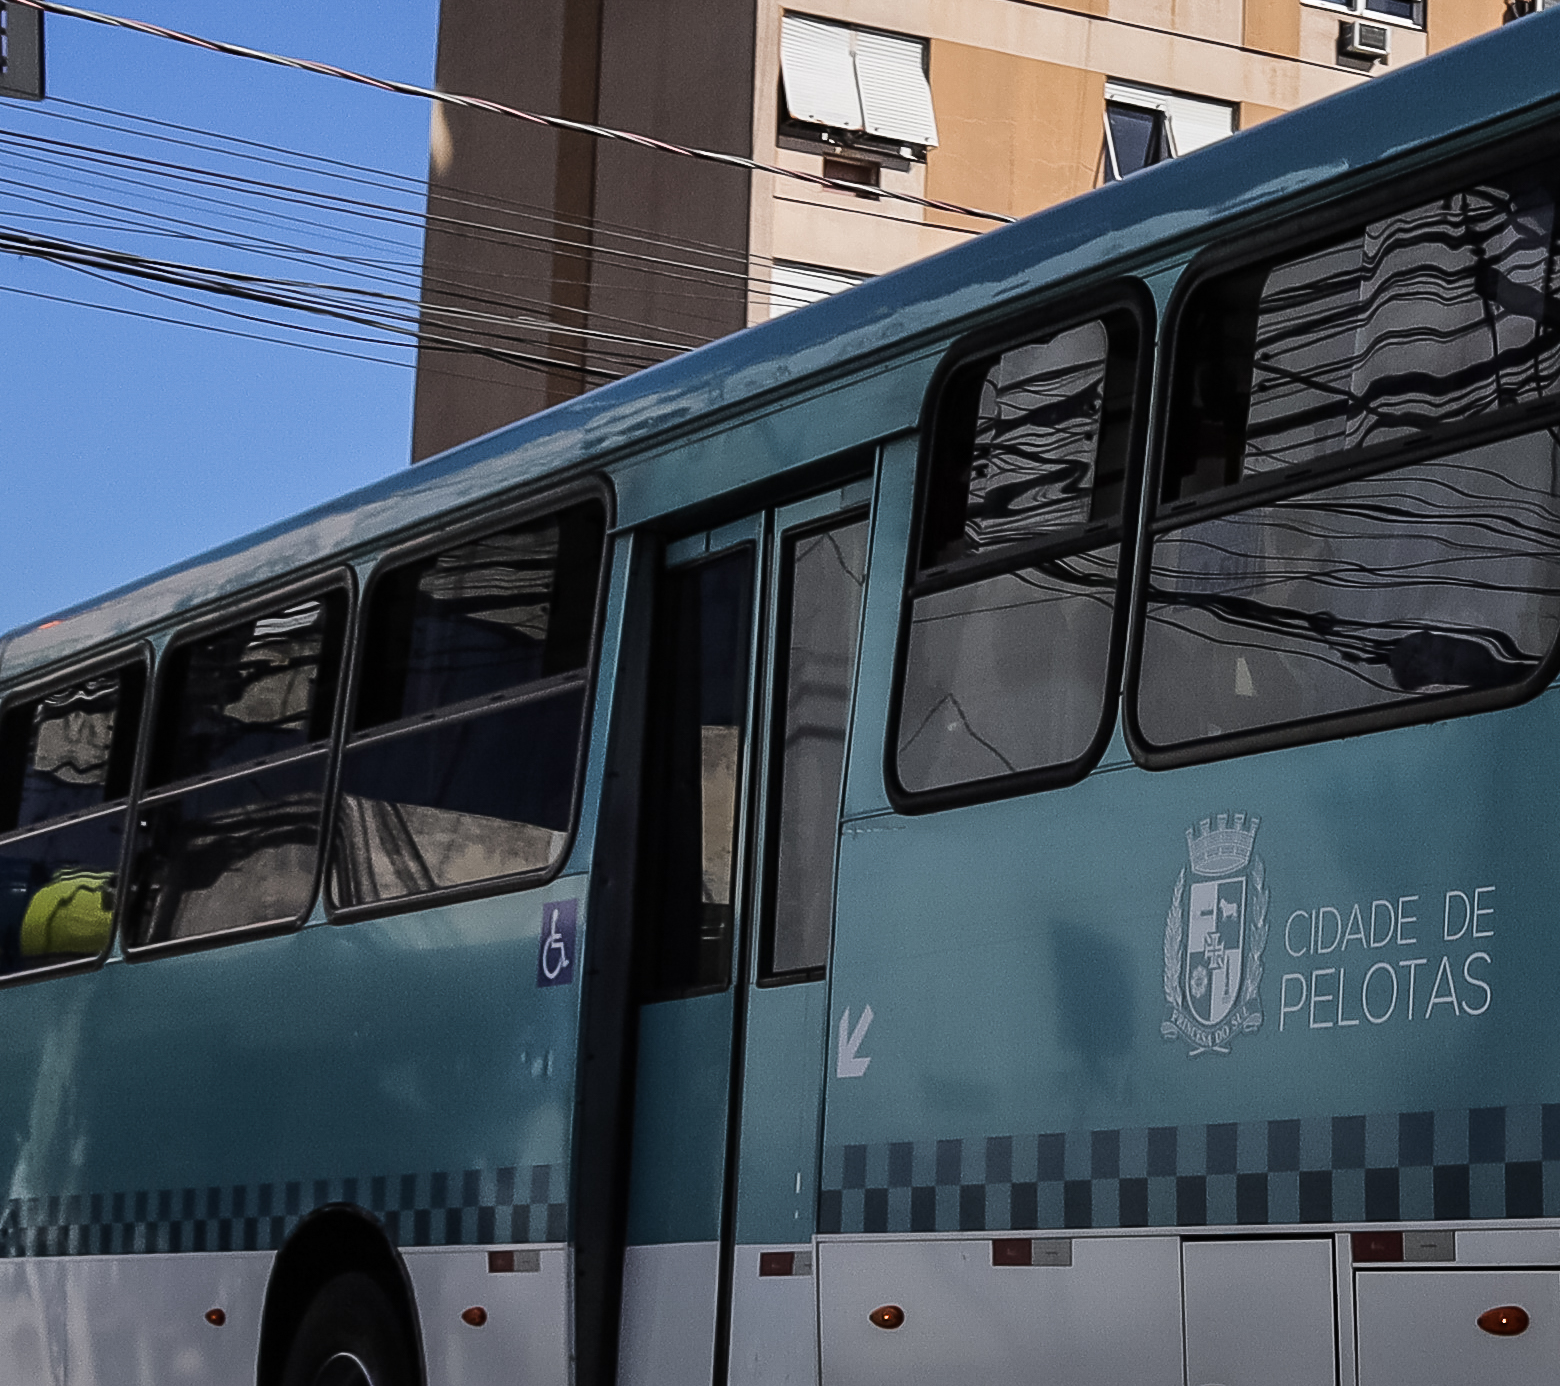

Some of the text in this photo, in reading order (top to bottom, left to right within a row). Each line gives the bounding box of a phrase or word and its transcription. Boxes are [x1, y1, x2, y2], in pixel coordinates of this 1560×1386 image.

[1284, 886, 1496, 957] CIDADE DE
[1279, 951, 1493, 1032] PELOTAS
[1170, 1009, 1213, 1048] PRINCESA
[1215, 1025, 1230, 1044] DO
